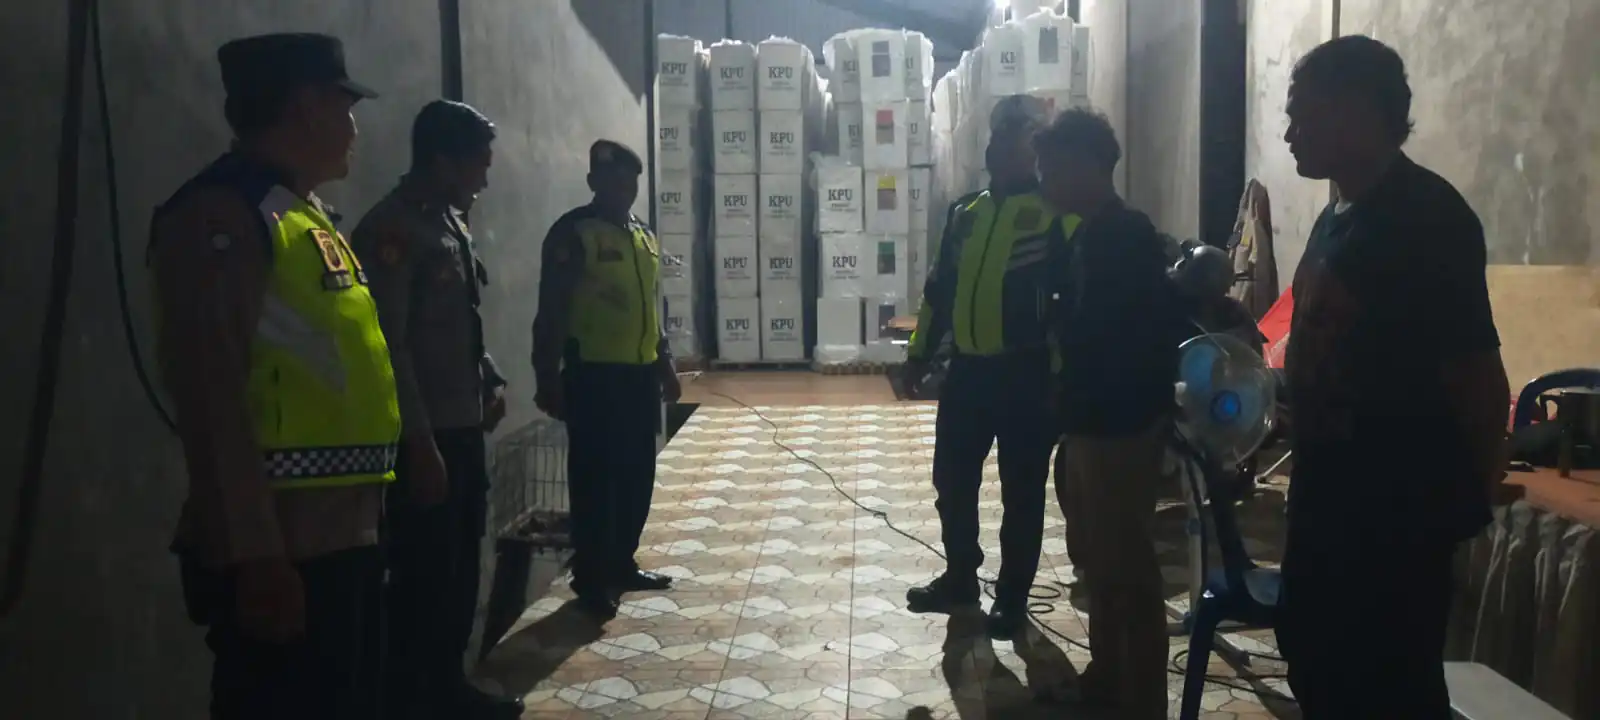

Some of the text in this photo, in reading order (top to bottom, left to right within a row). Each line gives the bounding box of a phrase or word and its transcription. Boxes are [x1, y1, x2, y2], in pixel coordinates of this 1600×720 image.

[662, 62, 688, 75] KPU
[720, 67, 744, 80] KPU
[768, 66, 793, 79] KPU
[723, 131, 746, 143] KPU
[770, 132, 794, 144] KPU
[724, 195, 748, 206] KPU
[768, 195, 793, 207] KPU
[828, 189, 853, 201] KPU
[723, 257, 748, 269] KPU
[769, 257, 793, 269] KPU
[832, 256, 857, 268] KPU
[667, 316, 683, 328] PU
[726, 318, 750, 330] KPU
[771, 318, 795, 330] KPU
